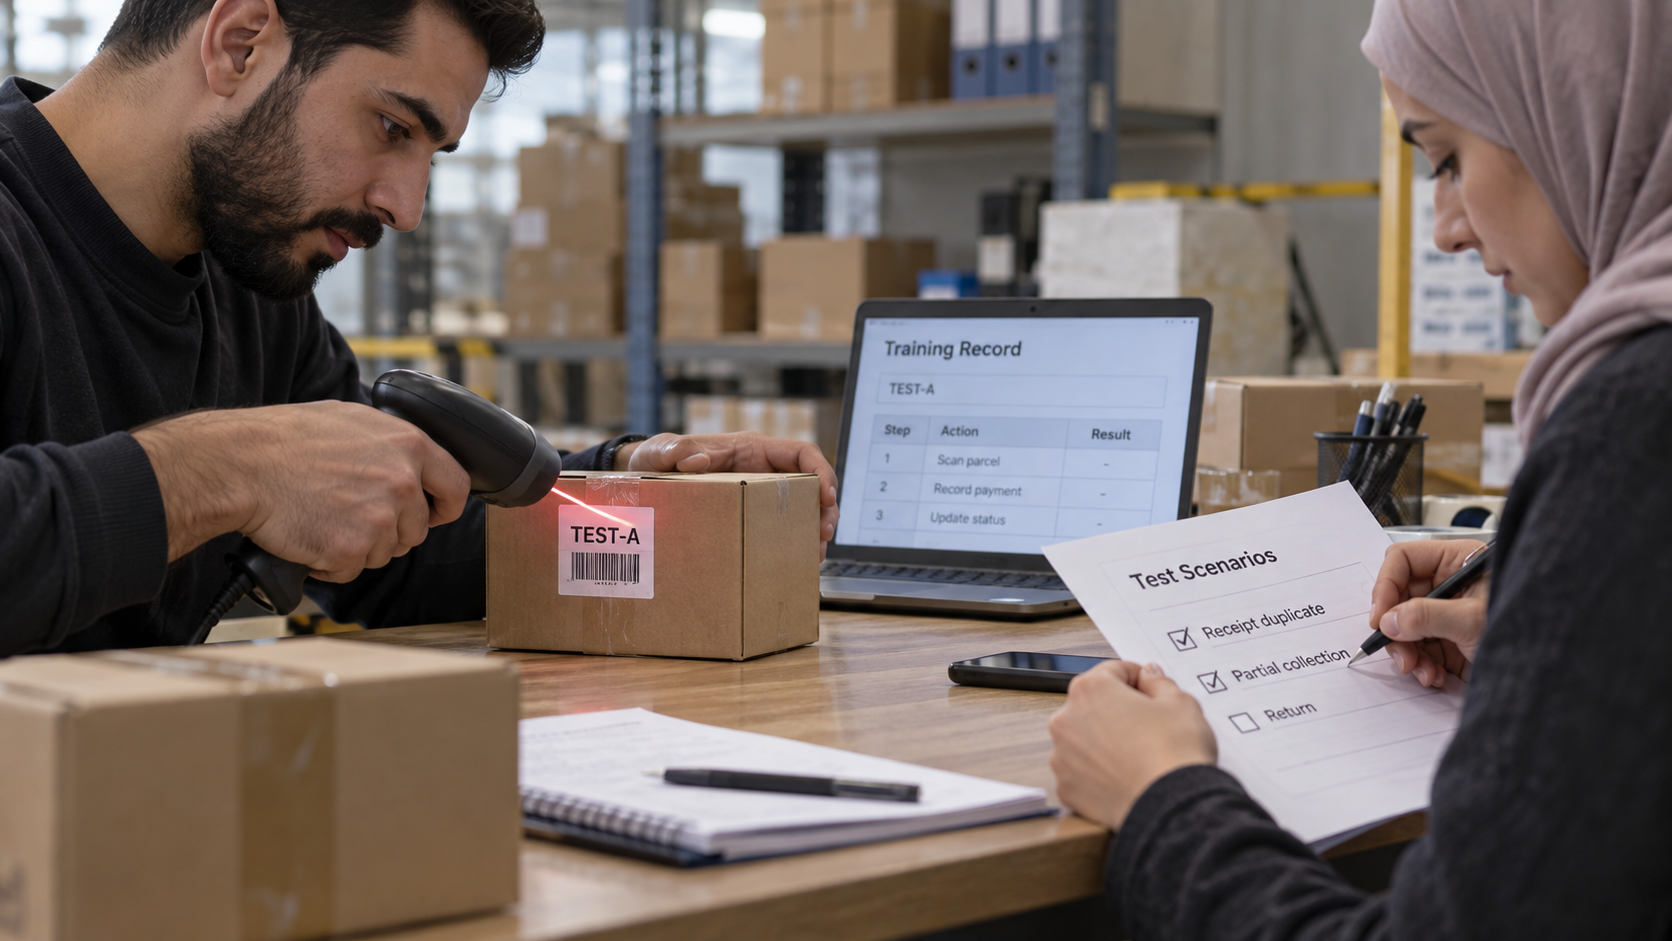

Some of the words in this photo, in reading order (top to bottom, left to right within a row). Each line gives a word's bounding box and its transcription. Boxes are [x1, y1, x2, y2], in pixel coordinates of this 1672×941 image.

[884, 340, 954, 360] Training
[960, 341, 1022, 357] Record
[889, 382, 935, 395] TEST-A
[885, 424, 911, 438] Step
[941, 425, 979, 437] Action
[1091, 428, 1131, 440] Result
[884, 453, 890, 463] 1
[937, 454, 964, 467] Scan
[966, 456, 1000, 468] parcel
[879, 481, 887, 492] 2
[934, 483, 972, 495] Record
[975, 486, 1022, 498] payment
[875, 510, 883, 521] 3
[930, 512, 969, 525] Update
[972, 514, 1006, 525] status
[570, 526, 640, 544] TEST-A
[1129, 568, 1179, 590] Test
[1178, 550, 1277, 580] Scenarios
[1202, 618, 1260, 640] Receipt
[1260, 603, 1326, 628] duplicate
[1231, 661, 1282, 682] Partial
[1282, 647, 1351, 671] collection
[1264, 702, 1317, 721] Return
